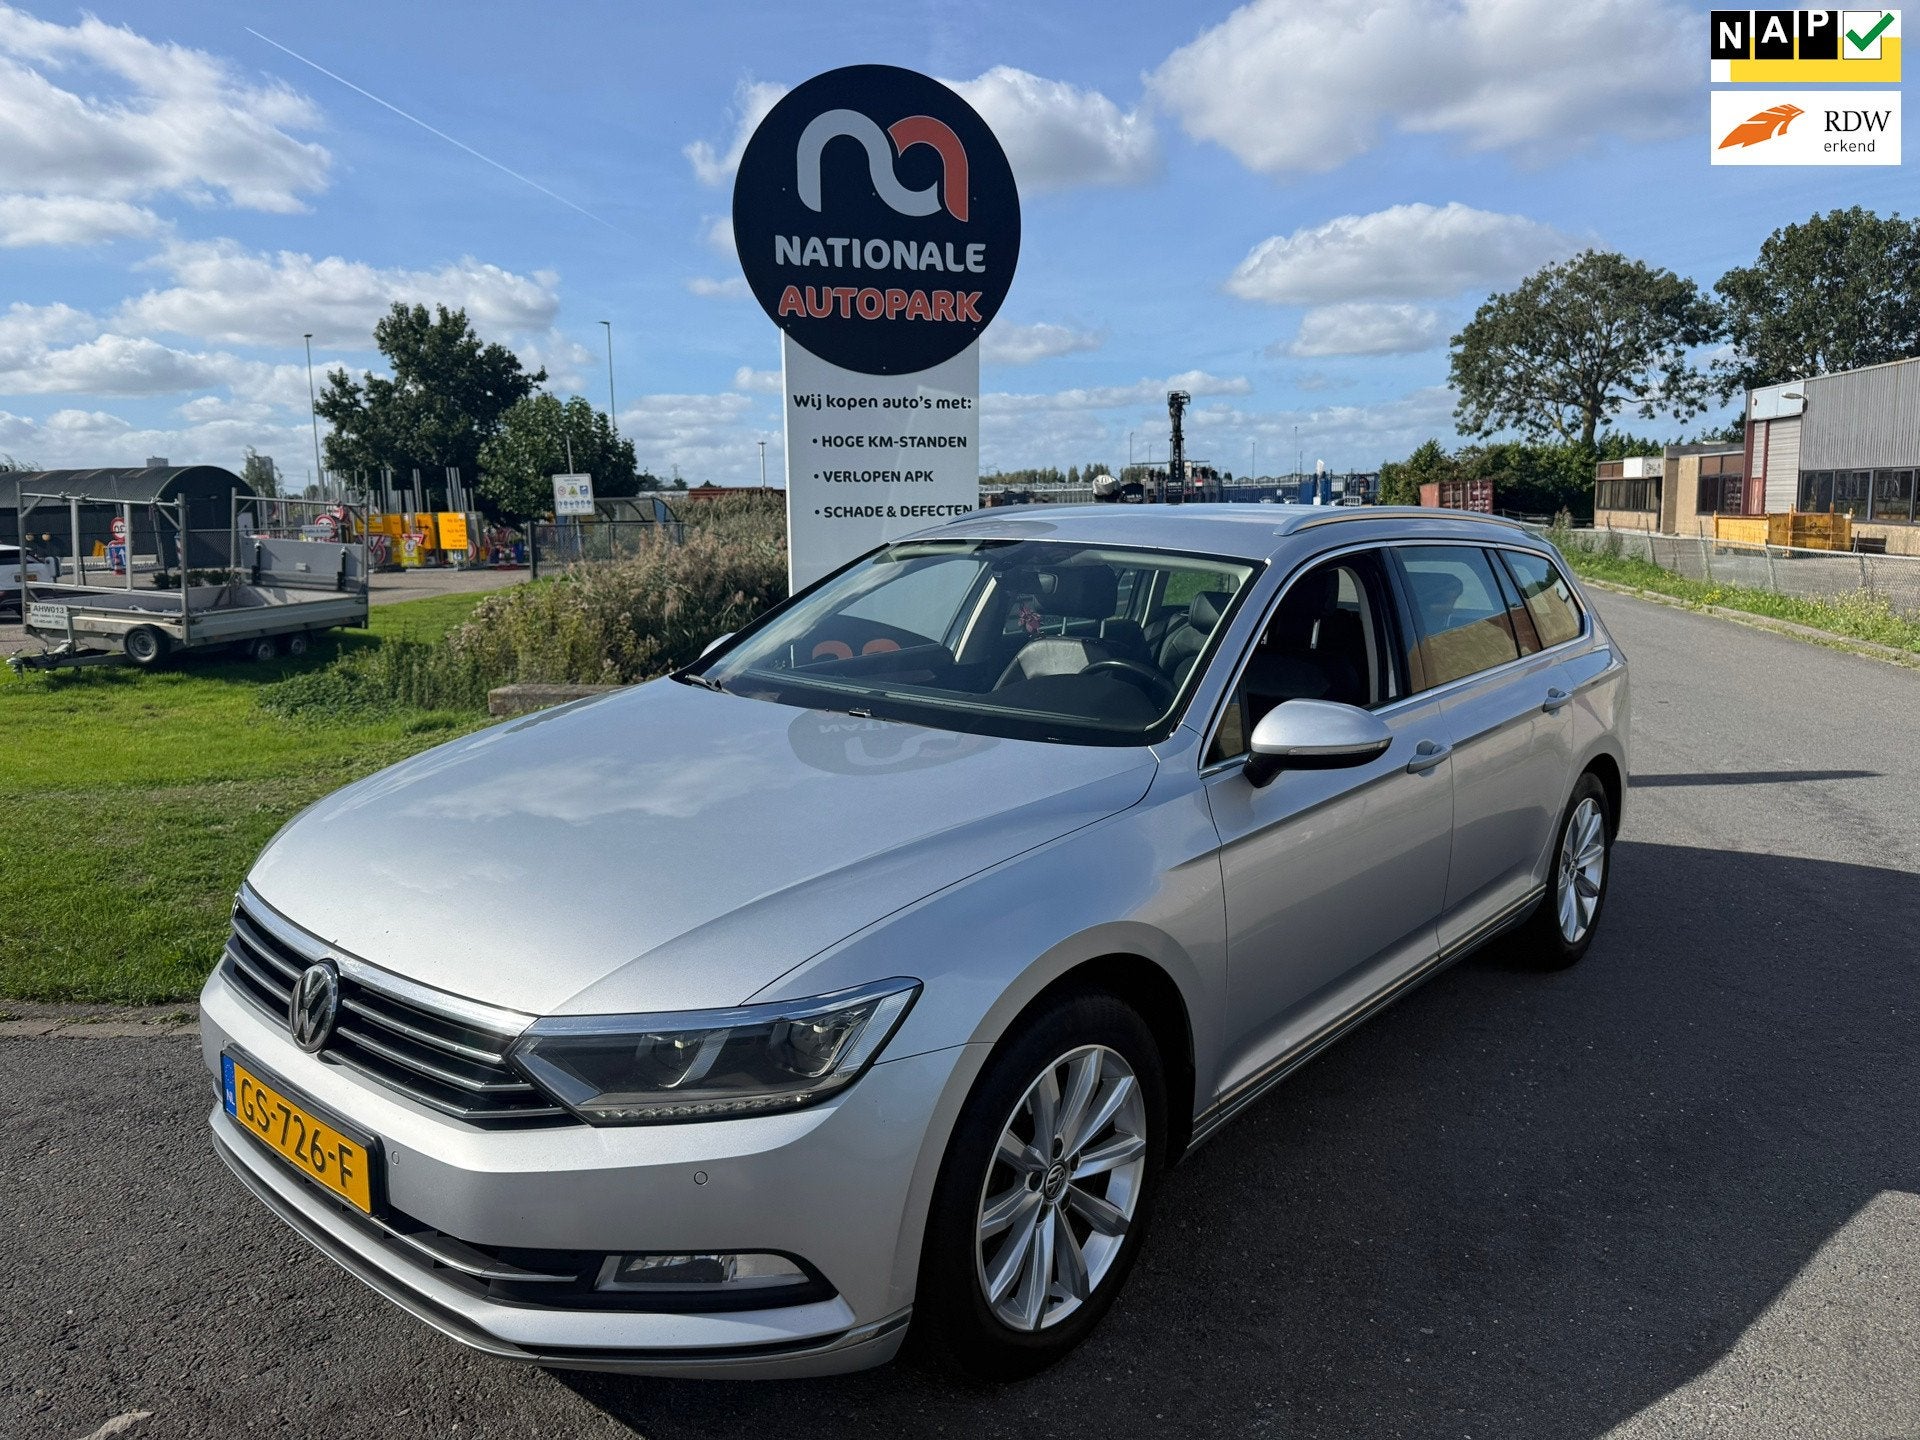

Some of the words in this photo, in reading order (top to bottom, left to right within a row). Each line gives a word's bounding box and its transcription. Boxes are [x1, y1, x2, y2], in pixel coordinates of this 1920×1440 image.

[775, 235, 986, 273] NATIONALE
[778, 285, 983, 323] AUTOPARK
[794, 394, 822, 411] Wij
[826, 395, 878, 411] kopen
[882, 396, 932, 409] auto's
[936, 397, 972, 410] met:
[821, 436, 865, 448] HOGE
[868, 436, 967, 448] KM-STANDEN
[823, 471, 901, 483] VERLOPEN
[904, 471, 934, 483] APK
[824, 506, 883, 518] SCHADE
[886, 506, 897, 518] &
[241, 1078, 354, 1188] GS-726-F
